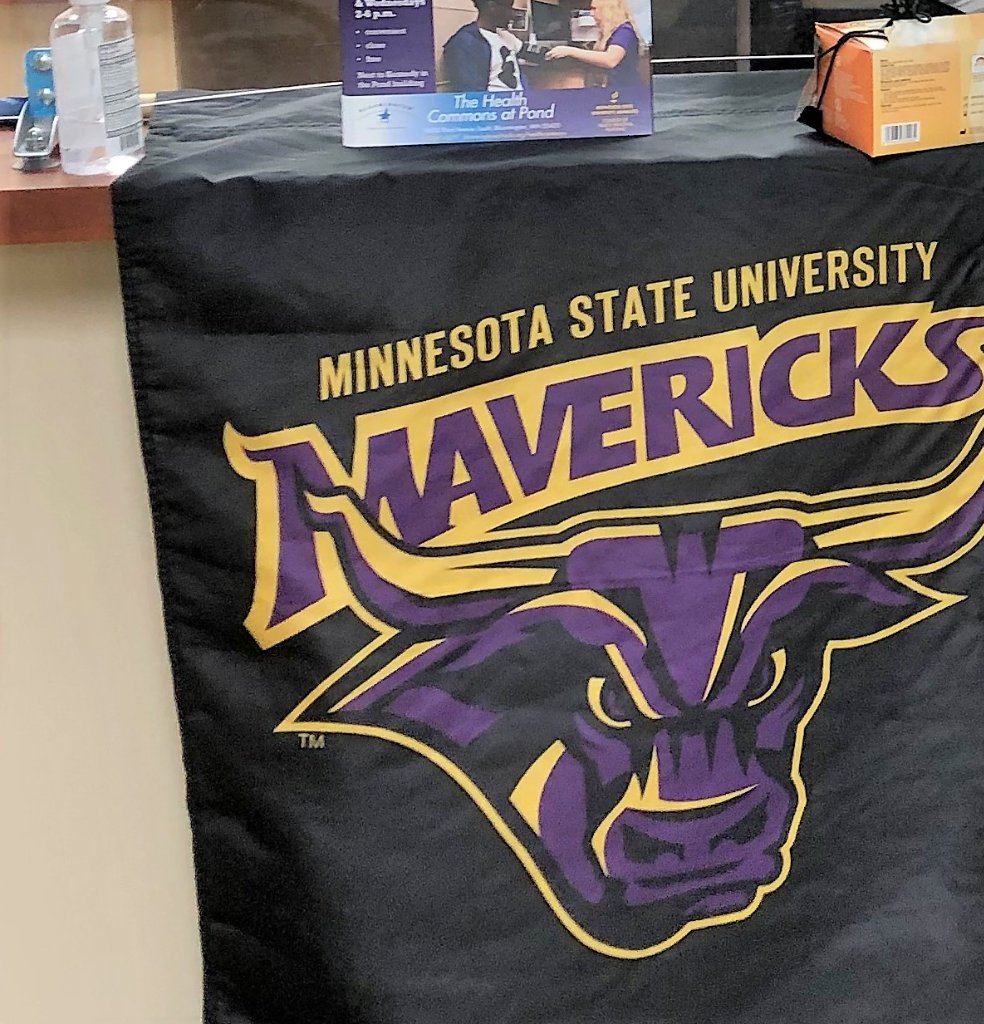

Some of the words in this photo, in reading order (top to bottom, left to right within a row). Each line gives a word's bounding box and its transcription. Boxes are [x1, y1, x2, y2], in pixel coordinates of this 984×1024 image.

[453, 93, 480, 109] The
[482, 91, 528, 108] Health
[427, 109, 498, 124] Commons
[500, 108, 517, 121] at
[519, 104, 555, 121] Pond
[317, 304, 554, 402] MINNESOTA
[568, 274, 696, 340] STATE
[711, 241, 939, 313] UNIVERSITY
[298, 733, 325, 749] TM
